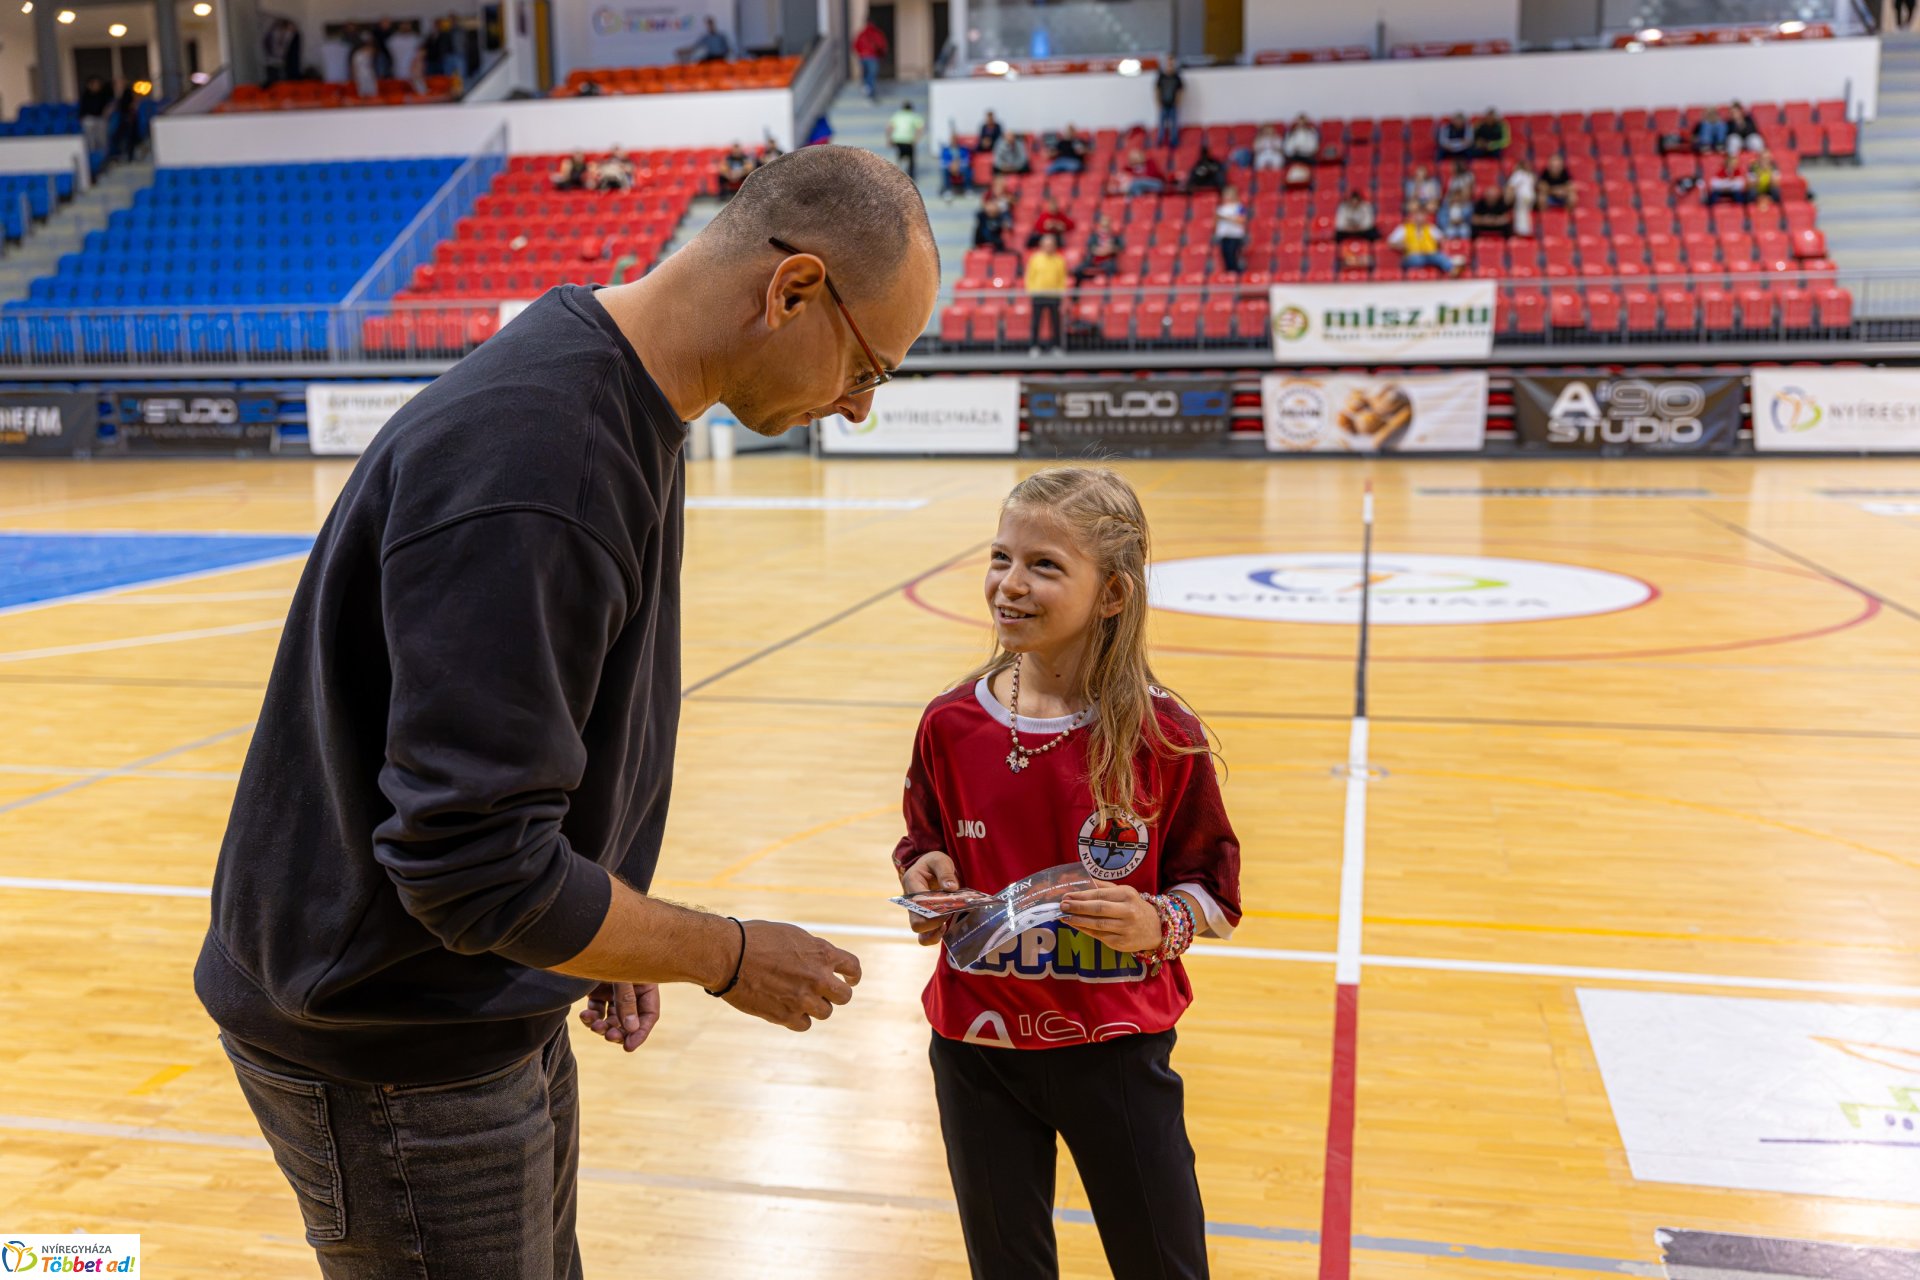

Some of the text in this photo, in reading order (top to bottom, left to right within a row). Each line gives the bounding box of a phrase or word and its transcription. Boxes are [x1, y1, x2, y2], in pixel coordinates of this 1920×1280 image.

[1324, 303, 1490, 327] mlsz.hu
[1547, 417, 1704, 443] STUDIO
[1089, 808, 1143, 832] FTSAL
[1081, 852, 1142, 878] NYÍREGYHÁZA
